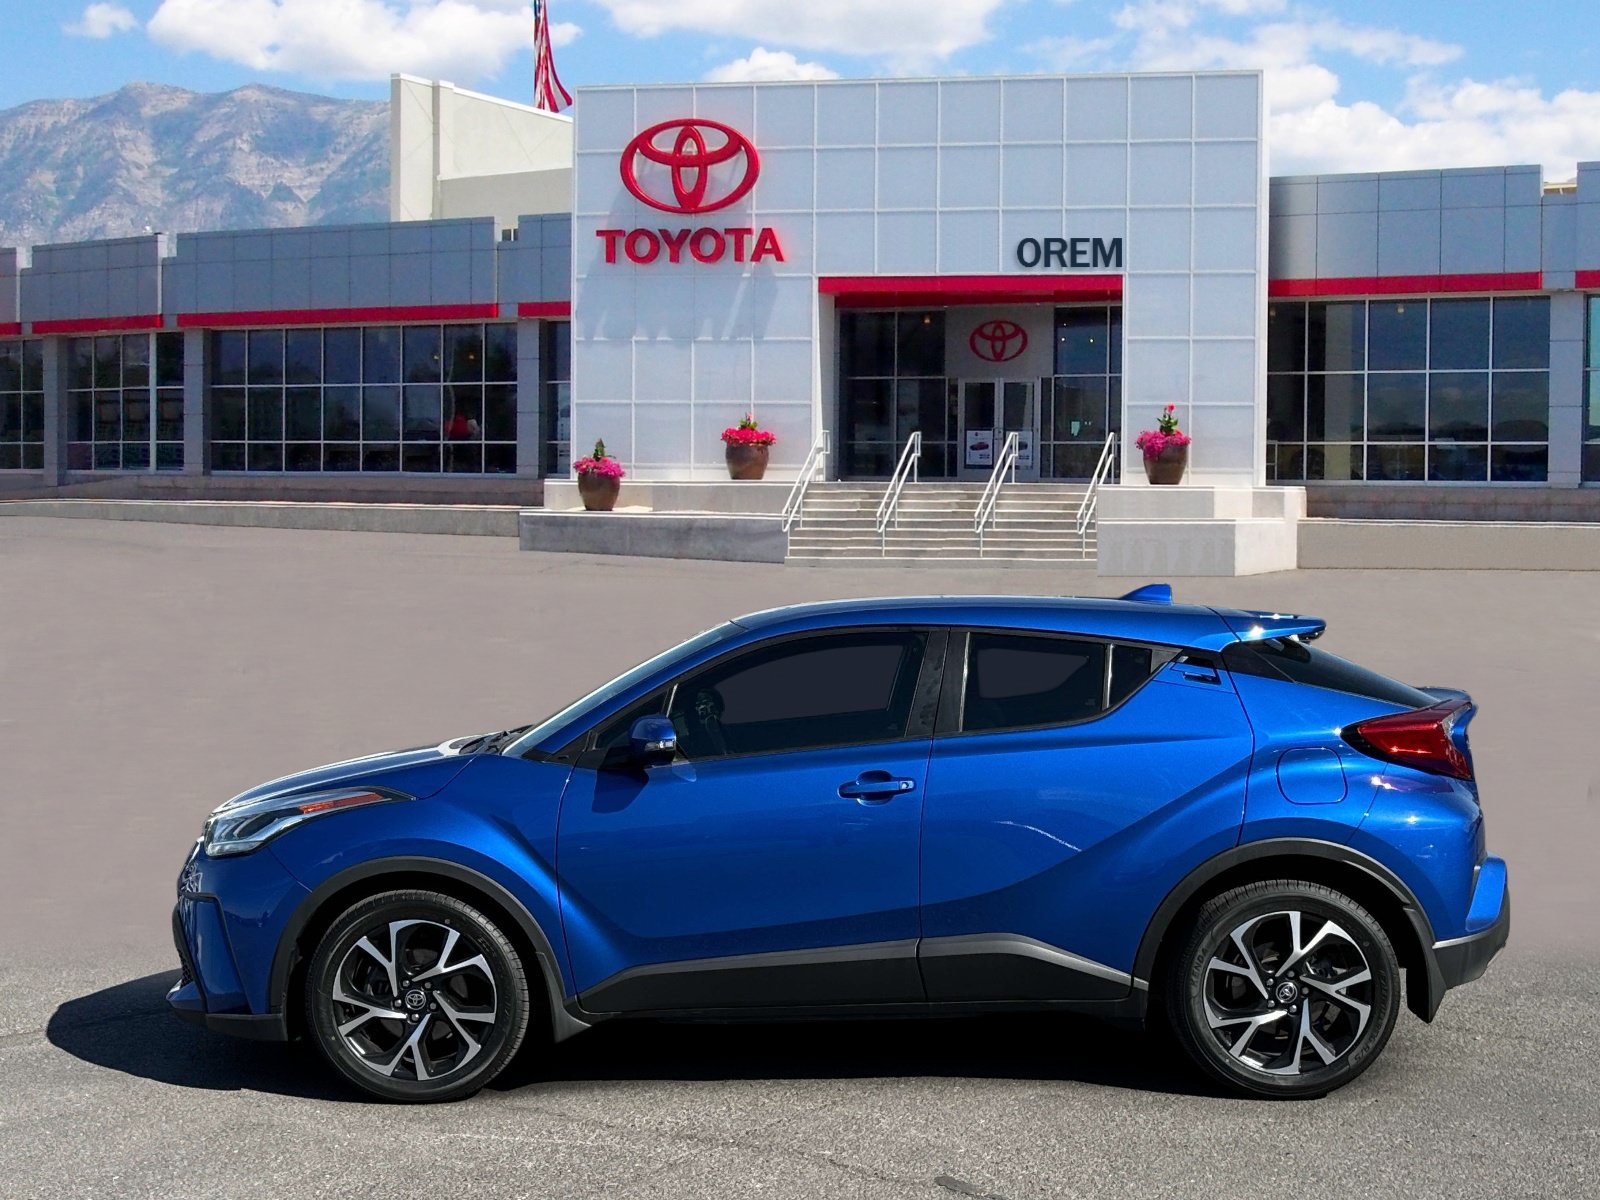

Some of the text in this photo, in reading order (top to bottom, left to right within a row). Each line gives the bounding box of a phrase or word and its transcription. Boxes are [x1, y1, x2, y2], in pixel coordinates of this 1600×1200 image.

[596, 228, 785, 264] TOYOTA
[1017, 238, 1122, 267] OREM
[1190, 947, 1210, 988] KENDA
